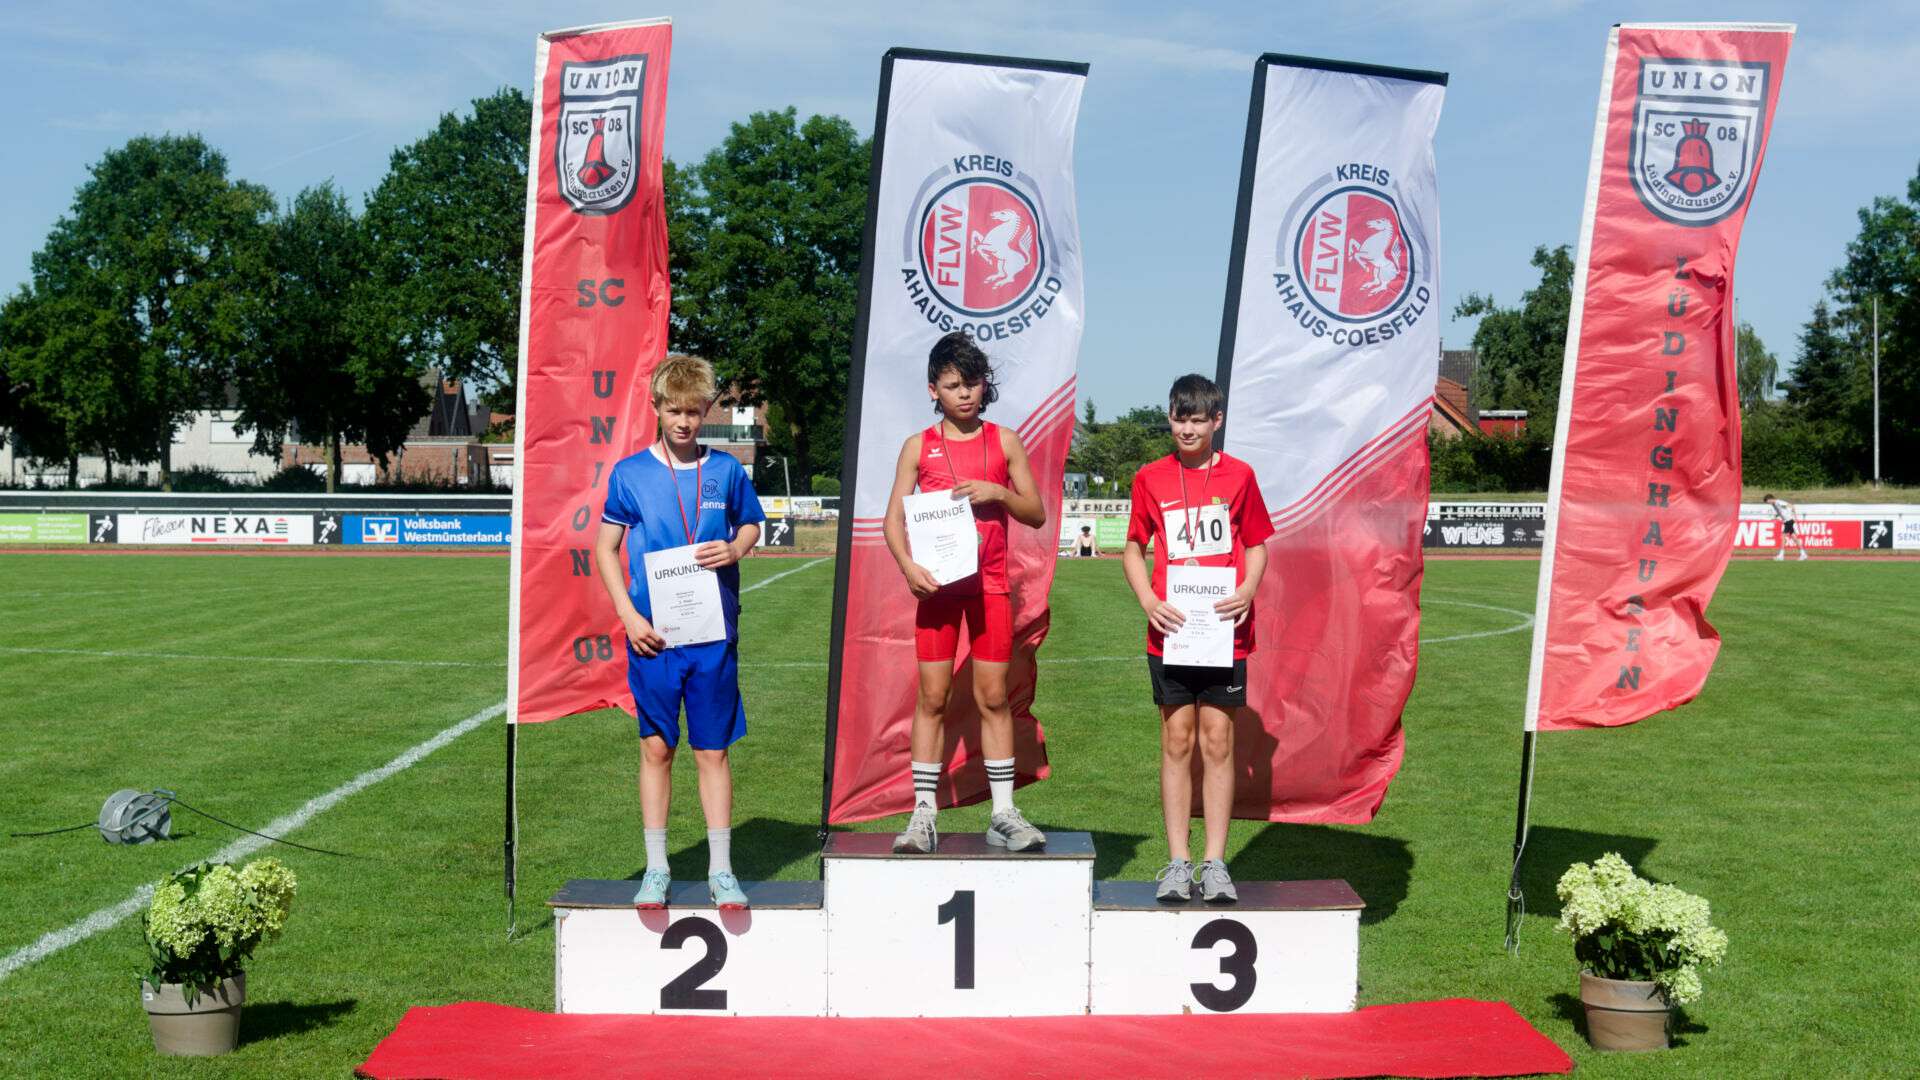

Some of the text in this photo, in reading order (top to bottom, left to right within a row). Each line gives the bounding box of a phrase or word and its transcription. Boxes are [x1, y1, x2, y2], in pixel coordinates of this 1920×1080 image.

[570, 66, 638, 90] UNION
[1650, 70, 1757, 94] UNION
[572, 120, 589, 135] SC
[608, 117, 623, 132] 08
[1653, 122, 1676, 138] SC
[1716, 126, 1738, 142] 08
[953, 154, 1014, 177] KREIS
[1336, 163, 1390, 186] KREIS
[1646, 163, 1725, 207] Lüdinghausen
[937, 203, 963, 287] FLVW
[1314, 210, 1343, 293] FLVW
[576, 278, 625, 308] SC
[901, 268, 1062, 342] AHAUS-COESFELD
[1272, 272, 1431, 347] AHAUS-COESFELD
[569, 370, 617, 578] UNION
[913, 503, 966, 523] URKUNDE
[1457, 506, 1541, 518] ENGELMANN
[191, 517, 270, 534] NEXA
[404, 518, 462, 530] Volksbank
[1177, 518, 1223, 545] 410
[1440, 525, 1505, 545] WIENS
[404, 531, 503, 543] Westmünsterland
[1805, 536, 1834, 547] Markt
[1173, 584, 1228, 596] URKUNDE
[573, 634, 614, 663] 08
[938, 890, 975, 990] 1
[659, 916, 728, 1010] 2
[1189, 918, 1258, 1012] 3
